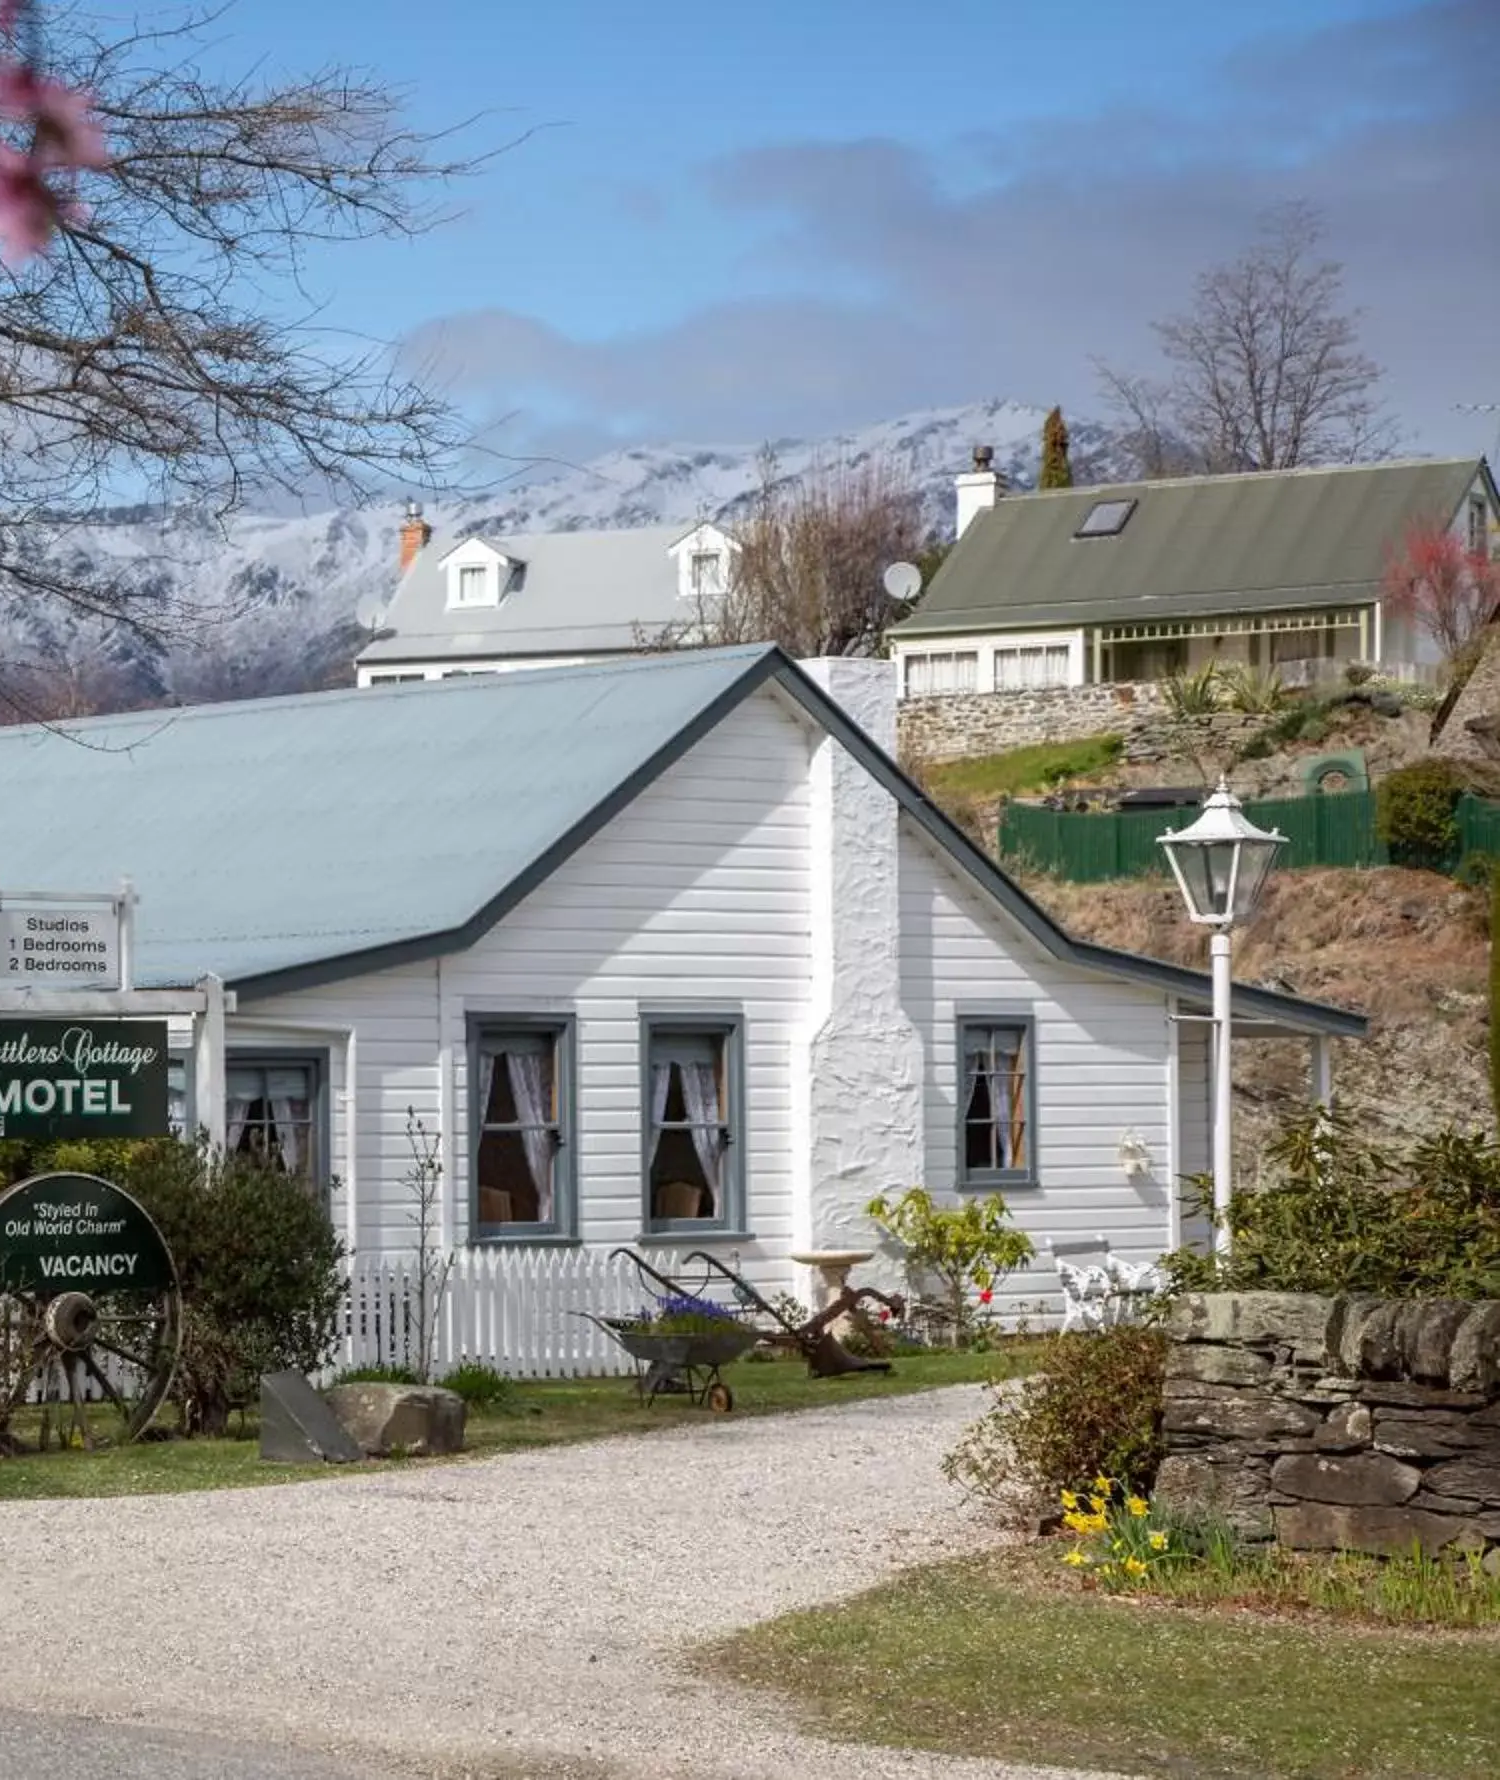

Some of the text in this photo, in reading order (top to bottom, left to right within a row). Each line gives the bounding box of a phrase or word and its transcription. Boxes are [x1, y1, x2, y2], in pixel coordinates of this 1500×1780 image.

[26, 917, 89, 932] Studios
[9, 937, 107, 952] 1 Bedrooms
[9, 957, 107, 972] 2 Bedrooms
[61, 1027, 158, 1075] Cottage
[5, 1220, 31, 1236] Old
[33, 1220, 73, 1235] World
[39, 1253, 139, 1277] VACANCY
